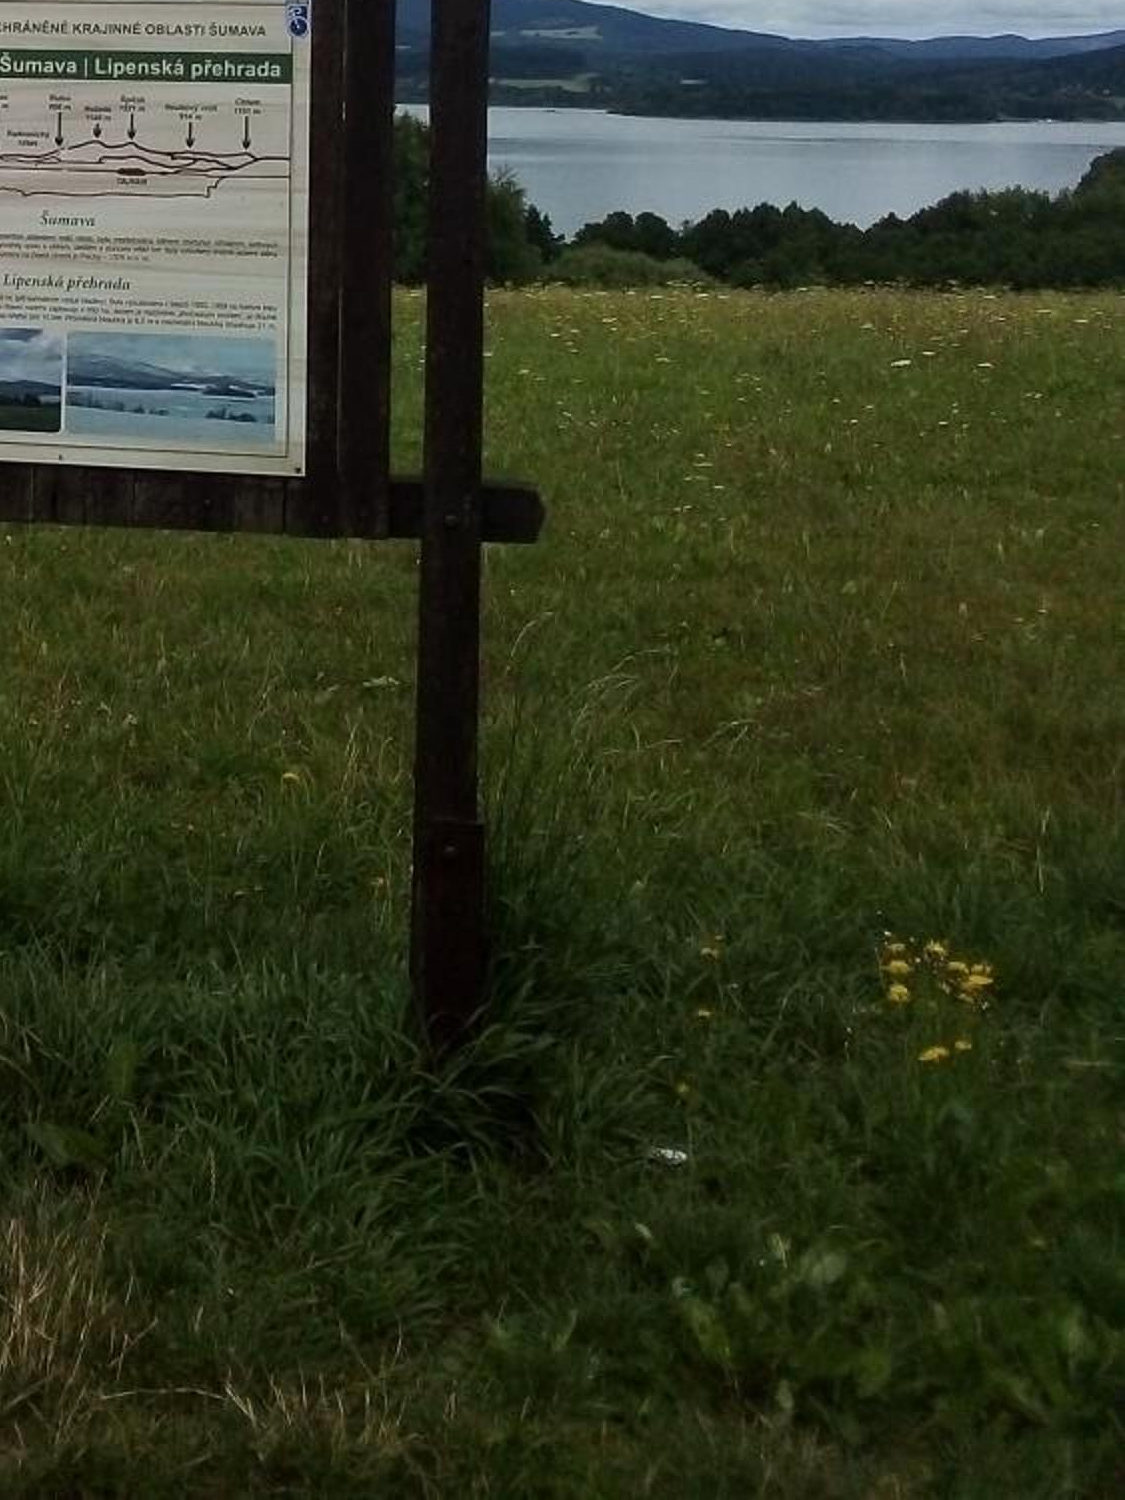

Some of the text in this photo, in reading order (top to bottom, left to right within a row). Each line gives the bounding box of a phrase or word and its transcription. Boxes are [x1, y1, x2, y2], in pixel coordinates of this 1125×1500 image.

[72, 21, 142, 35] KRAJINNÉ
[144, 22, 205, 36] OBLASTI
[208, 20, 266, 37] ŠUMAVA
[94, 57, 185, 79] Lipenská
[190, 59, 282, 80] přehrada
[40, 210, 96, 227] Šumava
[3, 272, 131, 292] Lipenská přehrada
